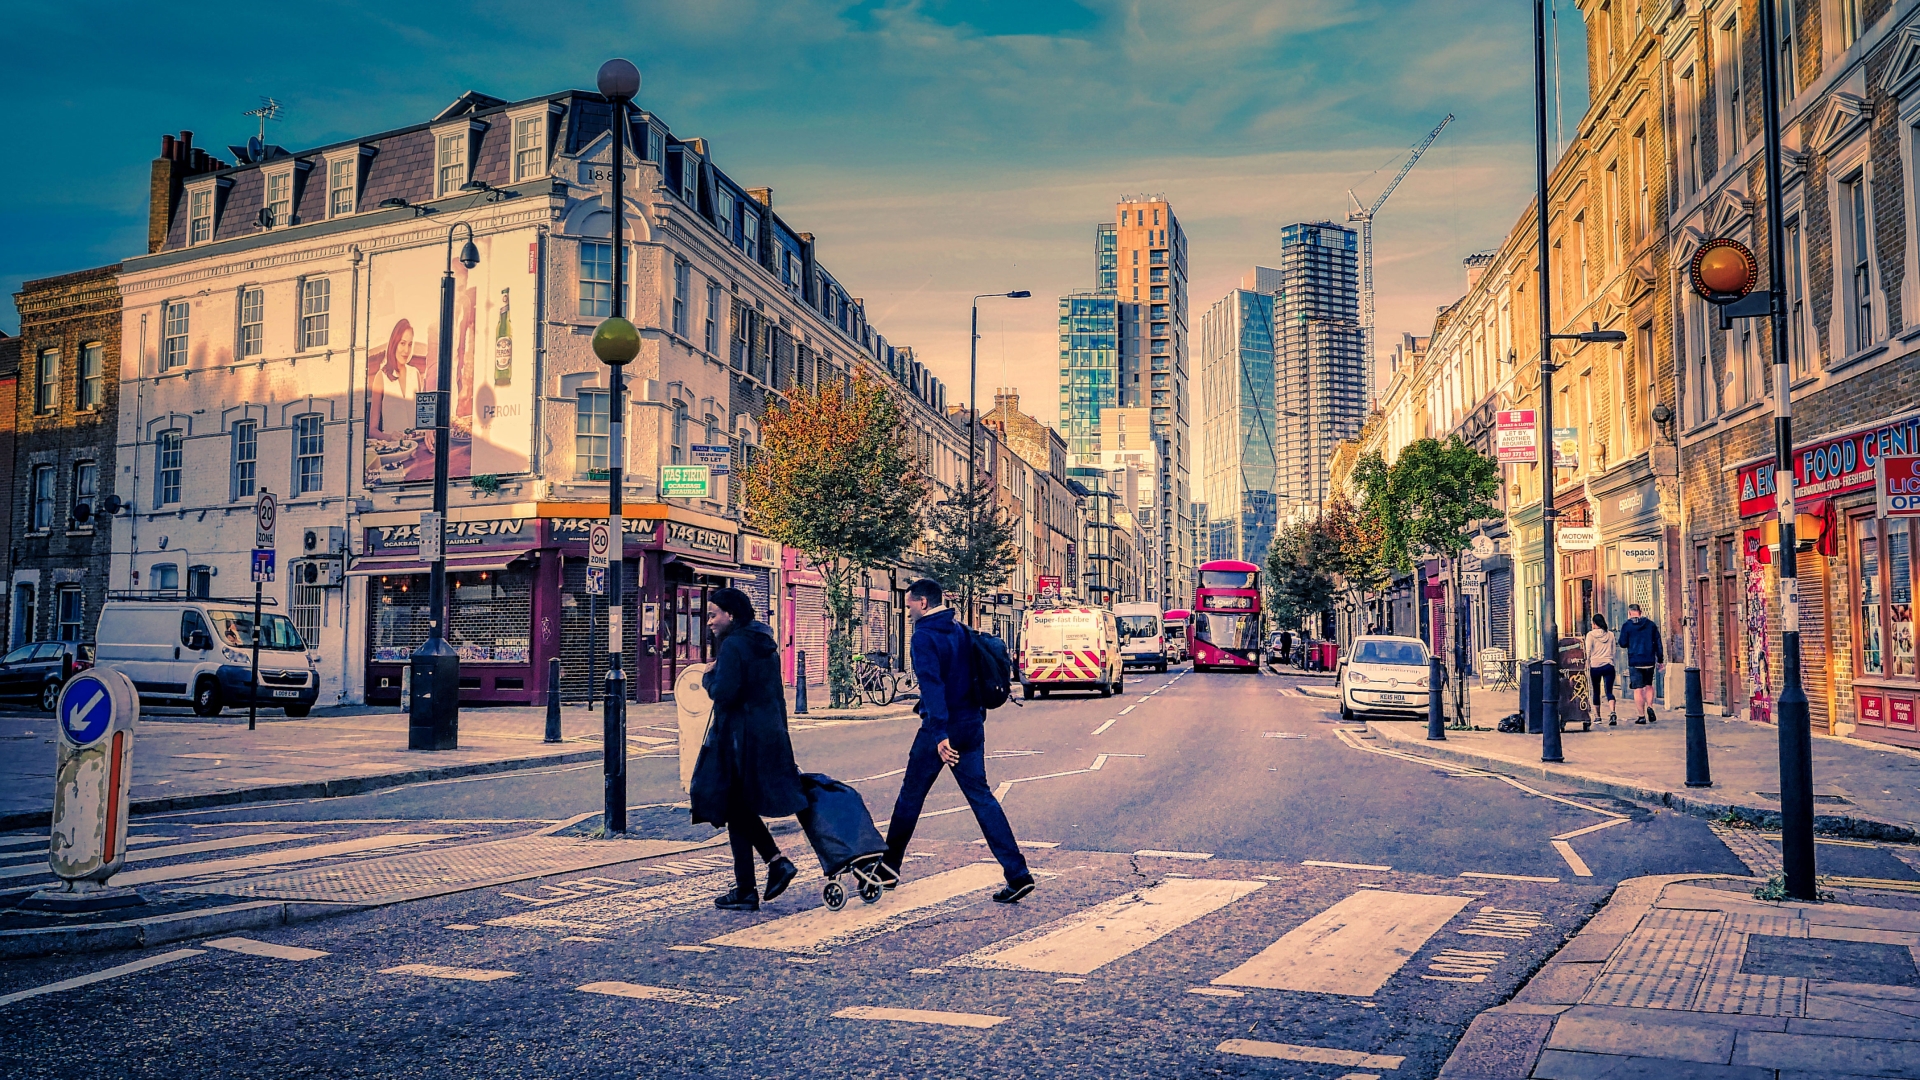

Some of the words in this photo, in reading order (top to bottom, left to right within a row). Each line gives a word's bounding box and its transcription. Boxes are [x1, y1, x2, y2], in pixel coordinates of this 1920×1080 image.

[484, 403, 521, 418] PERONI
[1803, 439, 1856, 484] FOOD
[682, 469, 706, 481] FIRIN
[1795, 482, 1828, 498] INTERNATIONAL
[1842, 474, 1860, 486] FRESH
[1860, 470, 1873, 482] FRUIT
[261, 505, 273, 521] 20
[258, 532, 273, 543] ZONE
[594, 534, 606, 547] 20
[696, 529, 730, 549] FIRIN
[1625, 548, 1655, 557] espacio
[590, 555, 607, 565] ZONE
[1636, 555, 1655, 563] gallery
[1034, 616, 1073, 624] Super-fast
[1481, 653, 1504, 662] COFFEE
[1868, 699, 1876, 708] OFF
[1893, 702, 1911, 712] ORGANIC
[1864, 708, 1880, 718] LICENCE
[1897, 712, 1908, 721] FOOD
